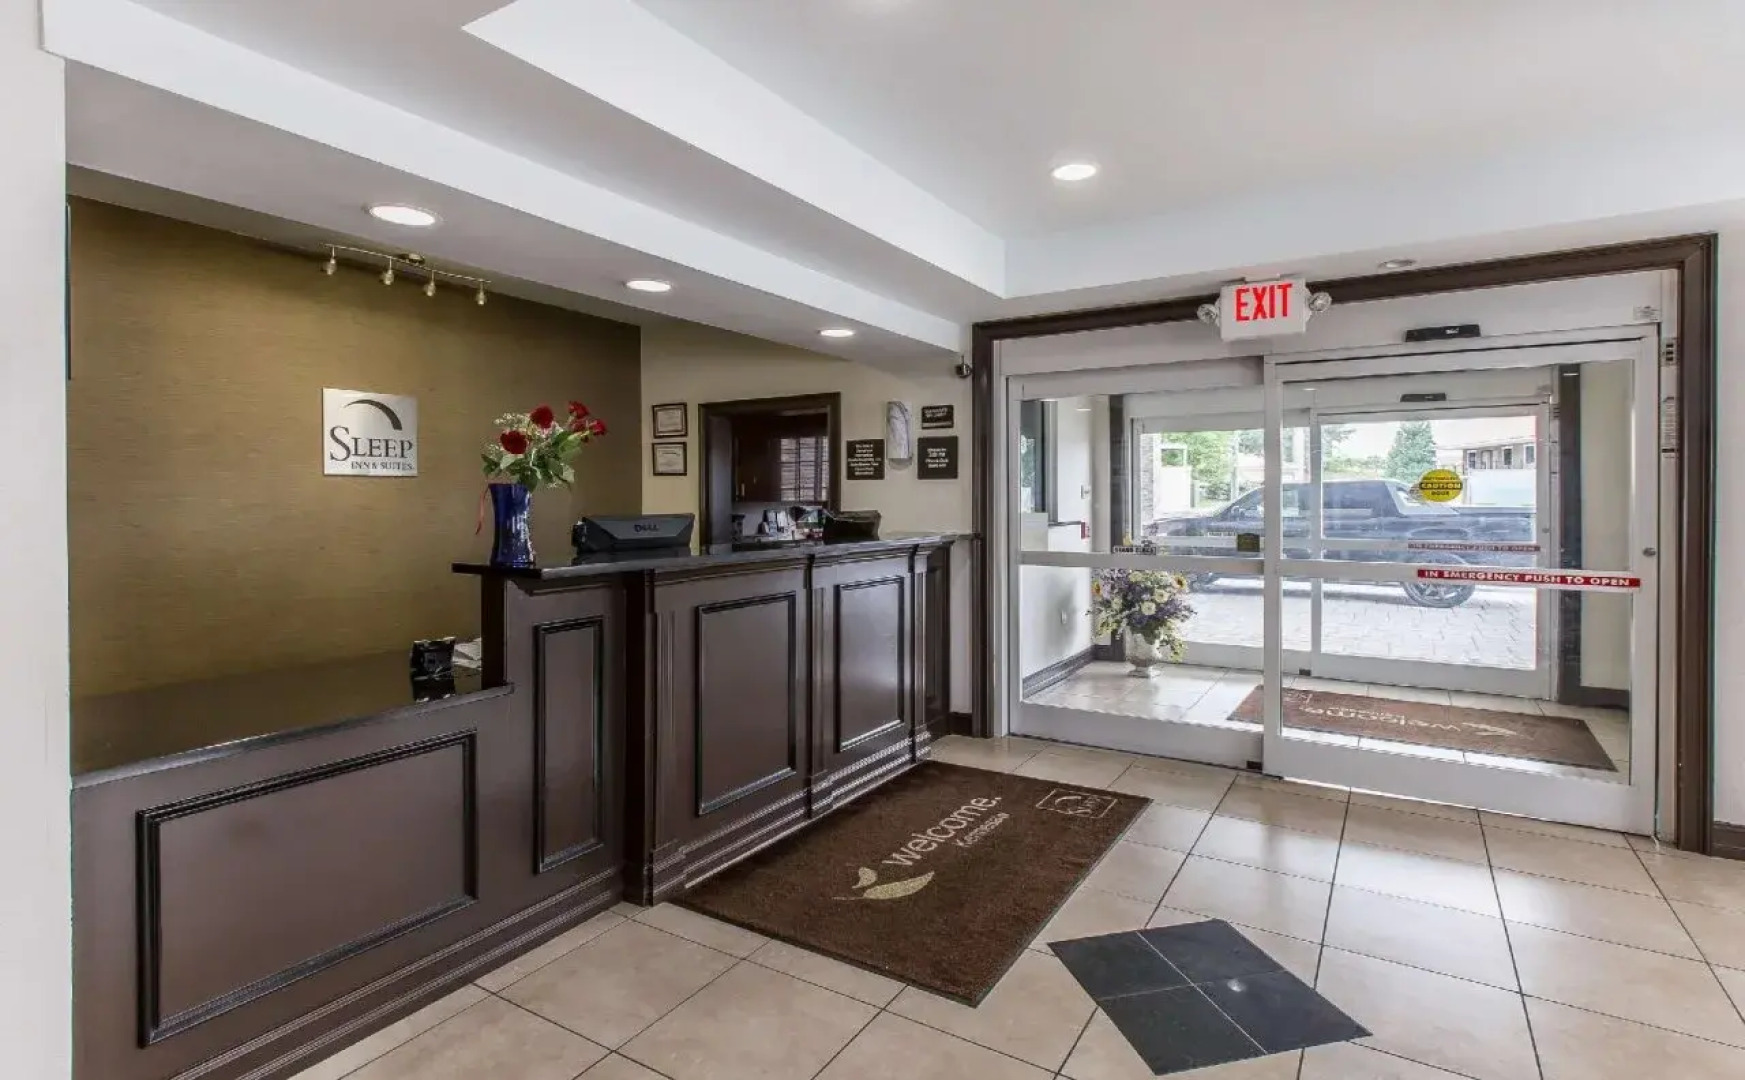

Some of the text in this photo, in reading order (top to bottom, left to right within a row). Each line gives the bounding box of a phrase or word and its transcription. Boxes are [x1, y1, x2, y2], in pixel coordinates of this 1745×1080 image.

[1235, 283, 1293, 322] EXIT
[329, 425, 413, 462] SLEEP
[351, 461, 413, 471] INN & SUITES
[1421, 482, 1462, 490] CAUTION
[634, 524, 660, 533] DELL
[1424, 569, 1630, 587] IN EMERGENCY PUSH TO OPEN
